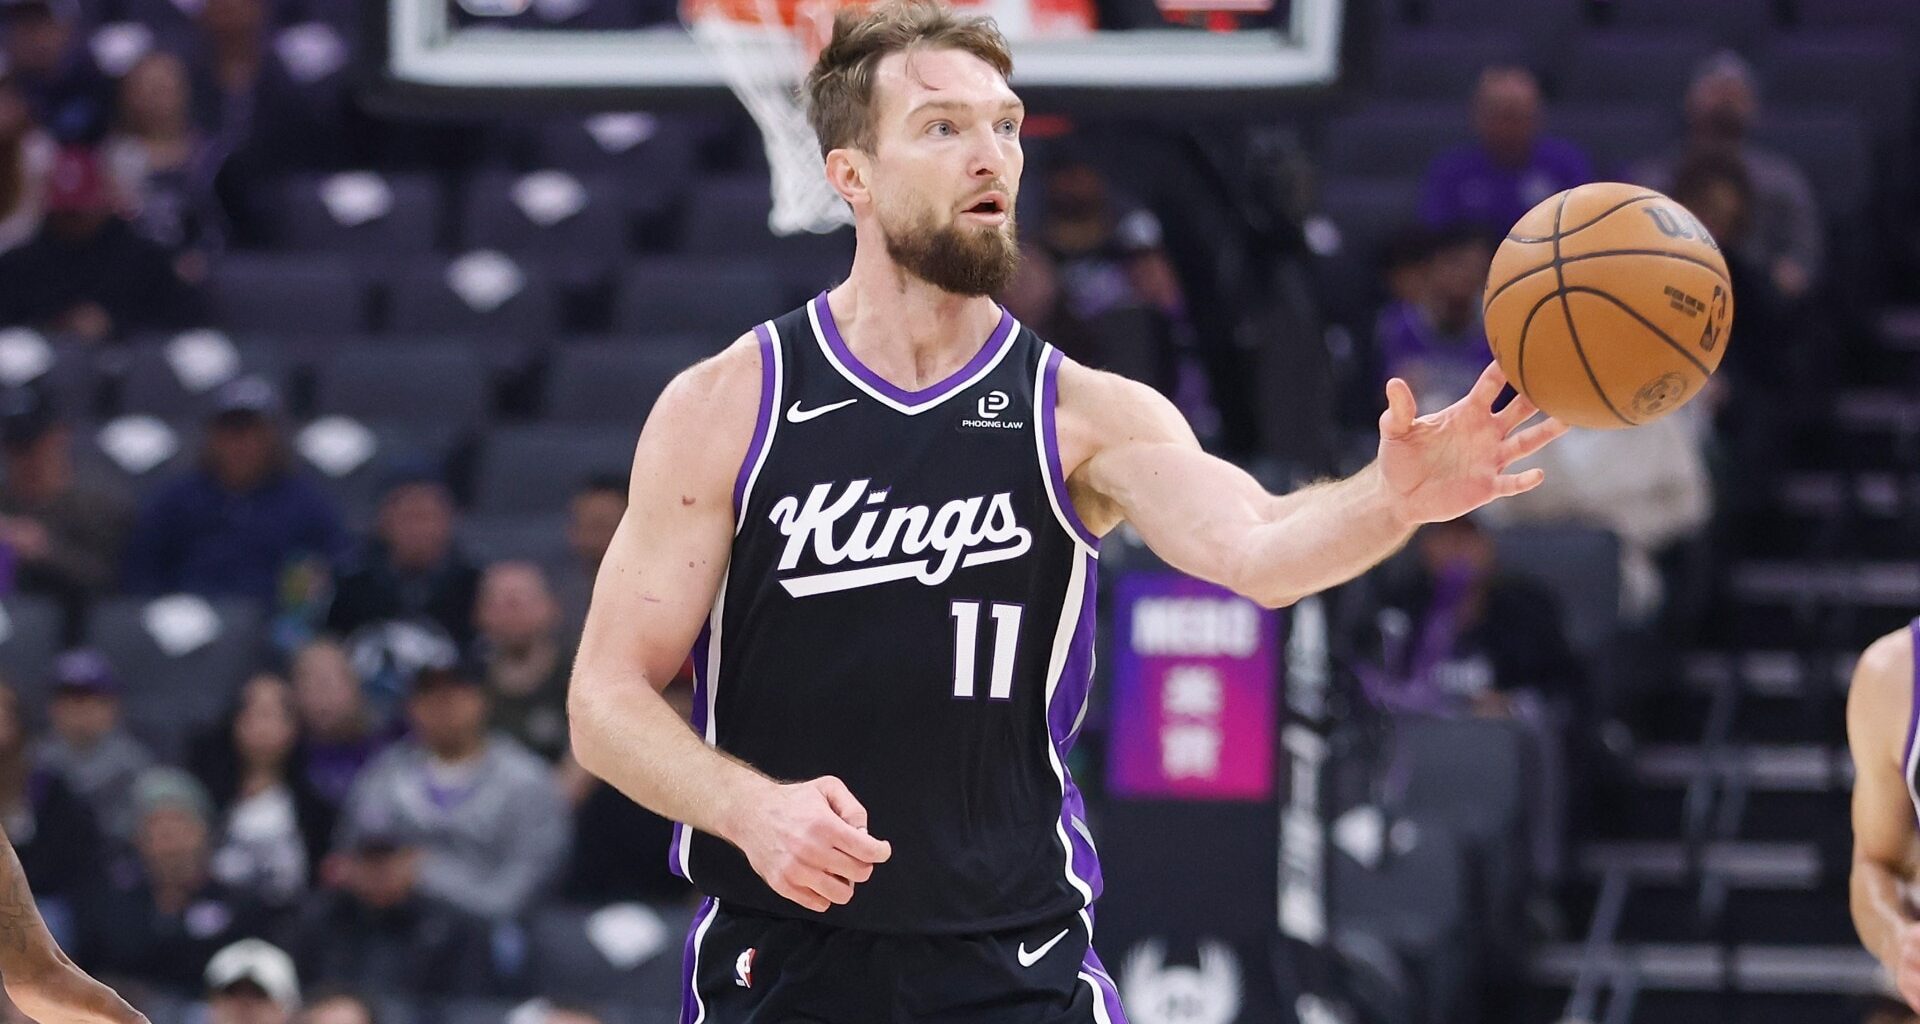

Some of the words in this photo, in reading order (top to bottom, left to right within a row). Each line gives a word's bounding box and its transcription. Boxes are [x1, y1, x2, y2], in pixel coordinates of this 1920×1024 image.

[962, 419, 1001, 428] PHOONG
[1002, 421, 1023, 429] LAW
[768, 477, 1032, 598] Kings
[949, 600, 1025, 700] 11
